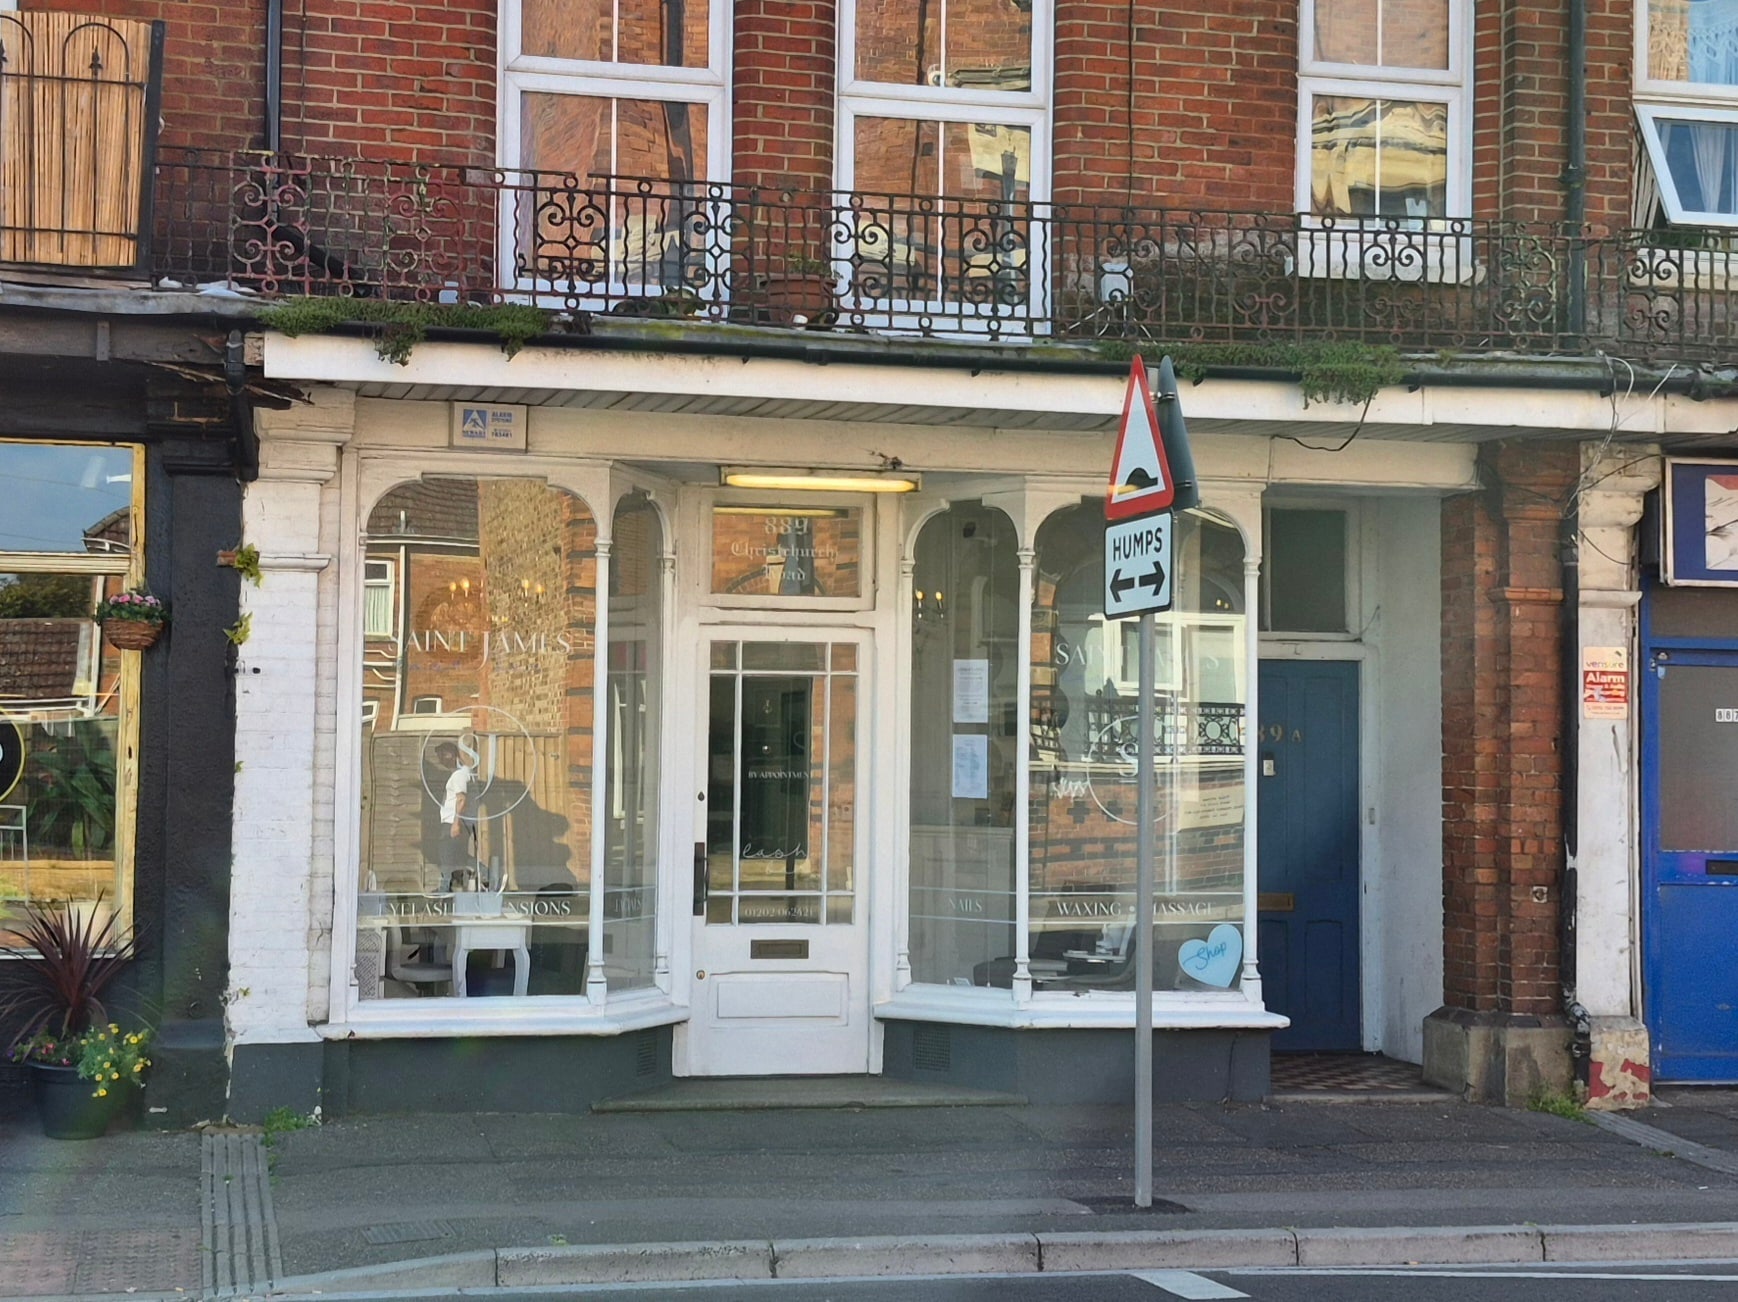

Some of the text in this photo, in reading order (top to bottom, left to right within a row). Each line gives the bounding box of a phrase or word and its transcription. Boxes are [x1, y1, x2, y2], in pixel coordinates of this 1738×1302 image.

[764, 516, 809, 535] 889
[1113, 527, 1163, 562] HUMPS
[389, 629, 468, 652] AINT
[1586, 671, 1626, 683] Alarm
[1056, 902, 1122, 916] WAXING
[1183, 942, 1227, 971] Shop
